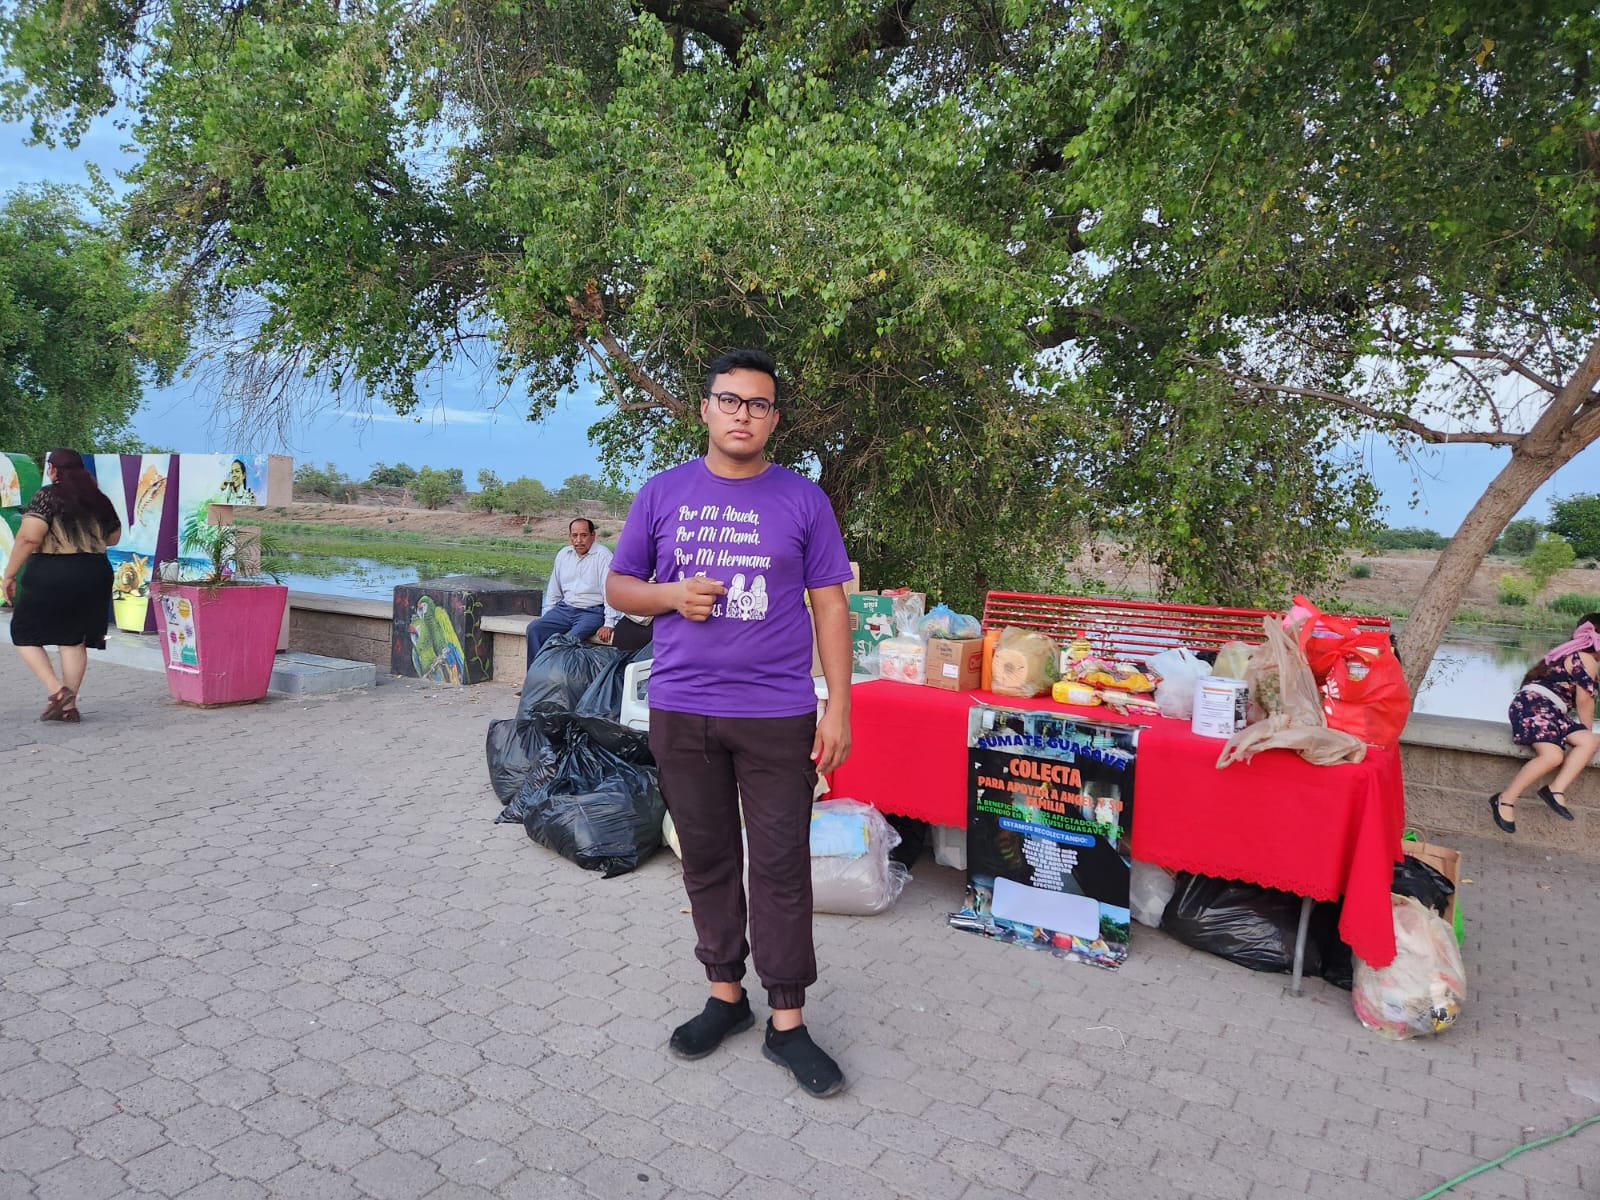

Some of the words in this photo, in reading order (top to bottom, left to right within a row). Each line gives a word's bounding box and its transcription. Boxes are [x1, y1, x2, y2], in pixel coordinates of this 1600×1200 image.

[679, 505, 698, 521] Por
[700, 505, 719, 520] Mi
[676, 526, 695, 542] Por
[697, 526, 717, 542] Mi
[674, 548, 692, 566] Por
[696, 548, 715, 566] Mi
[978, 735, 1043, 749] SUMATE
[1047, 736, 1128, 771] GUASAVE
[1009, 758, 1081, 788] COLECTA
[977, 775, 1005, 791] PARA
[1007, 780, 1049, 799] APOYAR
[1051, 789, 1059, 800] A
[1060, 791, 1094, 808] ANGEL
[1108, 799, 1123, 813] SU
[977, 806, 1010, 816] INCENDIO
[984, 800, 1019, 812] BENEFICIO
[1052, 815, 1098, 827] AFECTADOS
[1025, 797, 1065, 814] FAMILIA
[1003, 820, 1033, 833] ESTAMOS
